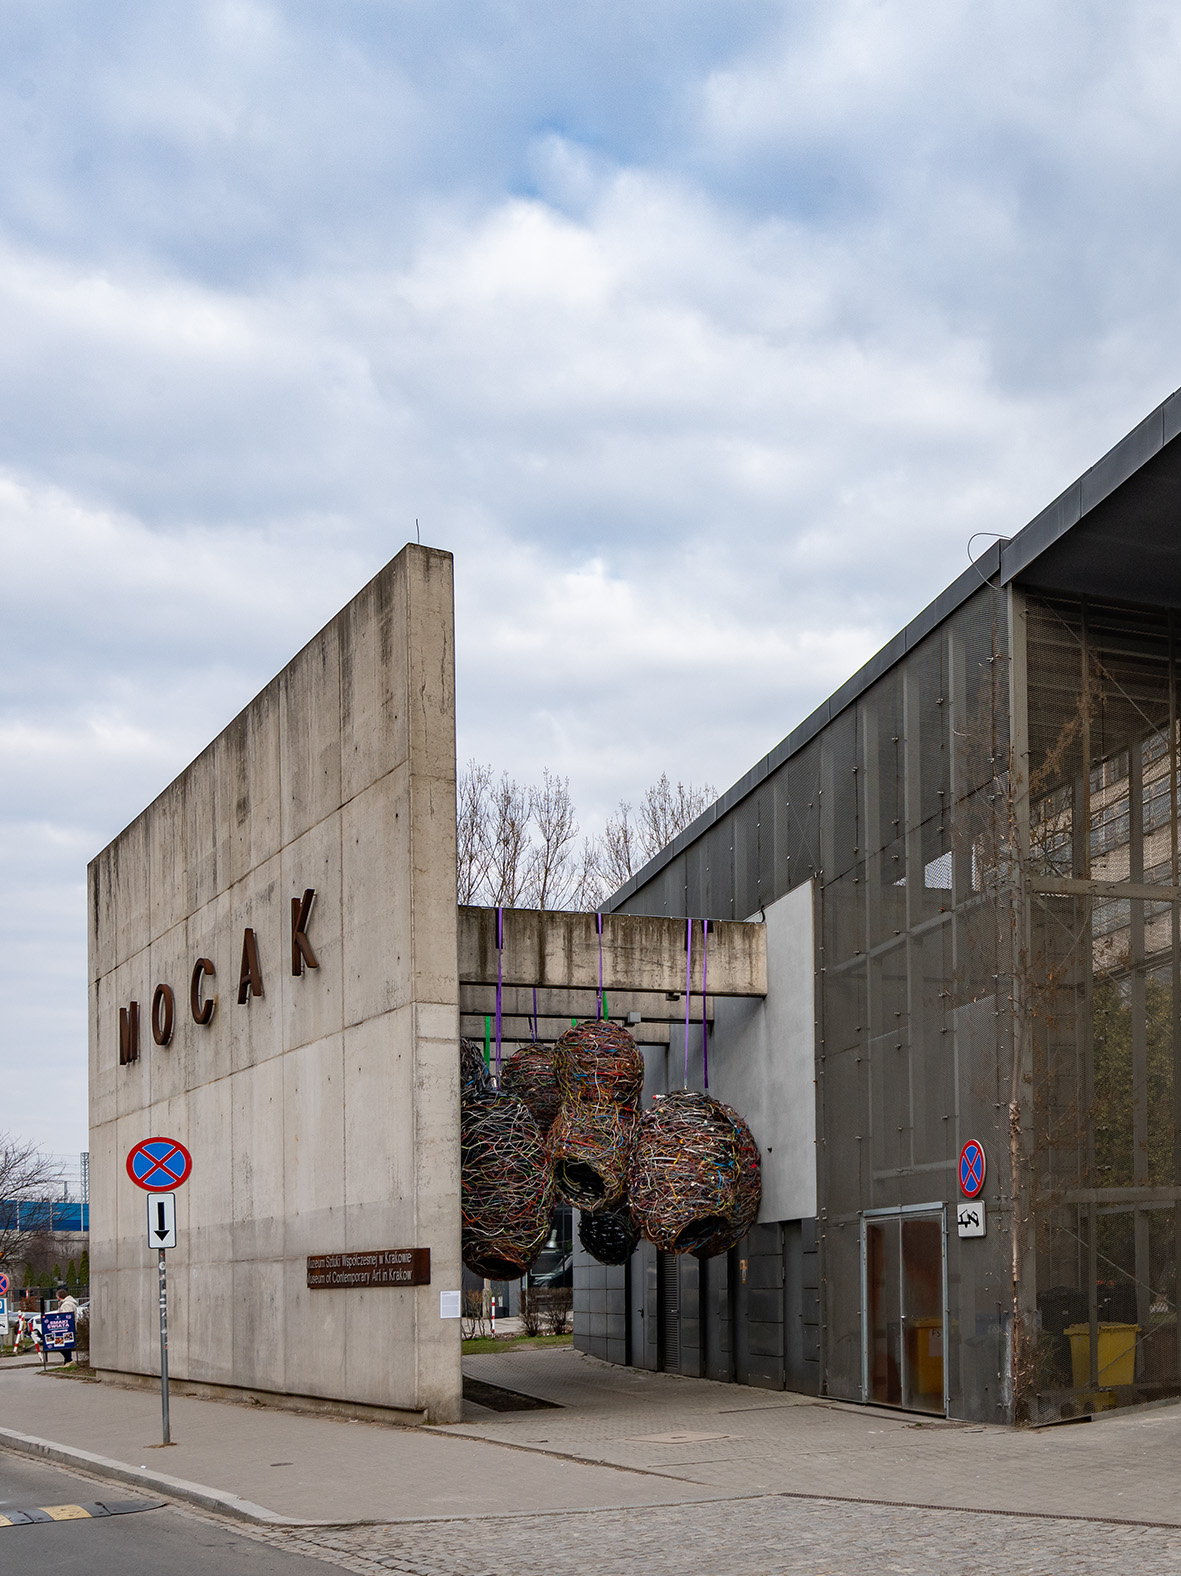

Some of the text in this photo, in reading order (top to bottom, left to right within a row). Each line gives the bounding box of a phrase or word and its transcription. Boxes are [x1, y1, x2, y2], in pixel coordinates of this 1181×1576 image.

[119, 888, 320, 1066] MOCAK
[385, 1250, 412, 1264] Krakowie
[325, 1271, 332, 1283] of
[332, 1271, 370, 1285] Contemporary
[372, 1269, 381, 1281] Art
[382, 1268, 388, 1281] in
